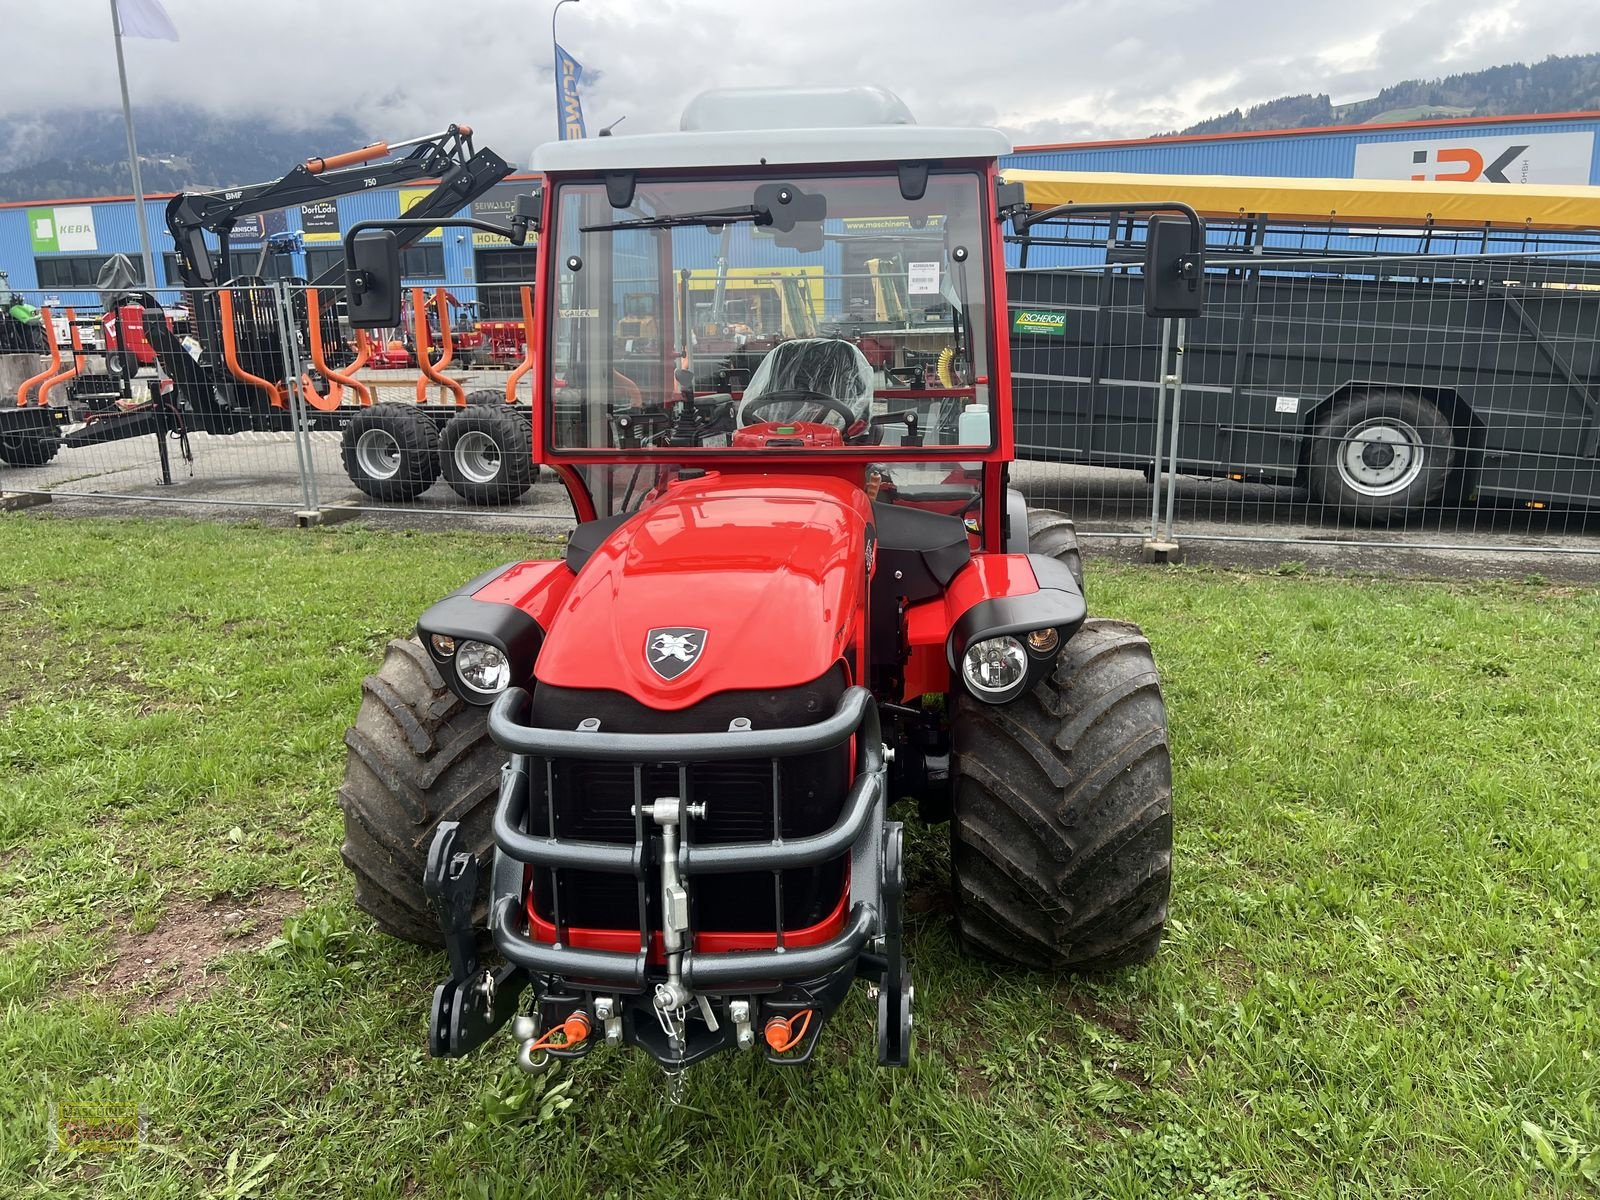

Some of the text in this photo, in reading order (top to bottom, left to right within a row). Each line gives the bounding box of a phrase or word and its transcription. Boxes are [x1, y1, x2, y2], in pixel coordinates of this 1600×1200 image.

[363, 178, 377, 187] 750
[225, 191, 243, 200] BMF
[474, 201, 511, 210] SEIWALD
[60, 224, 92, 234] KEBA
[1024, 313, 1065, 323] SCHEICKL
